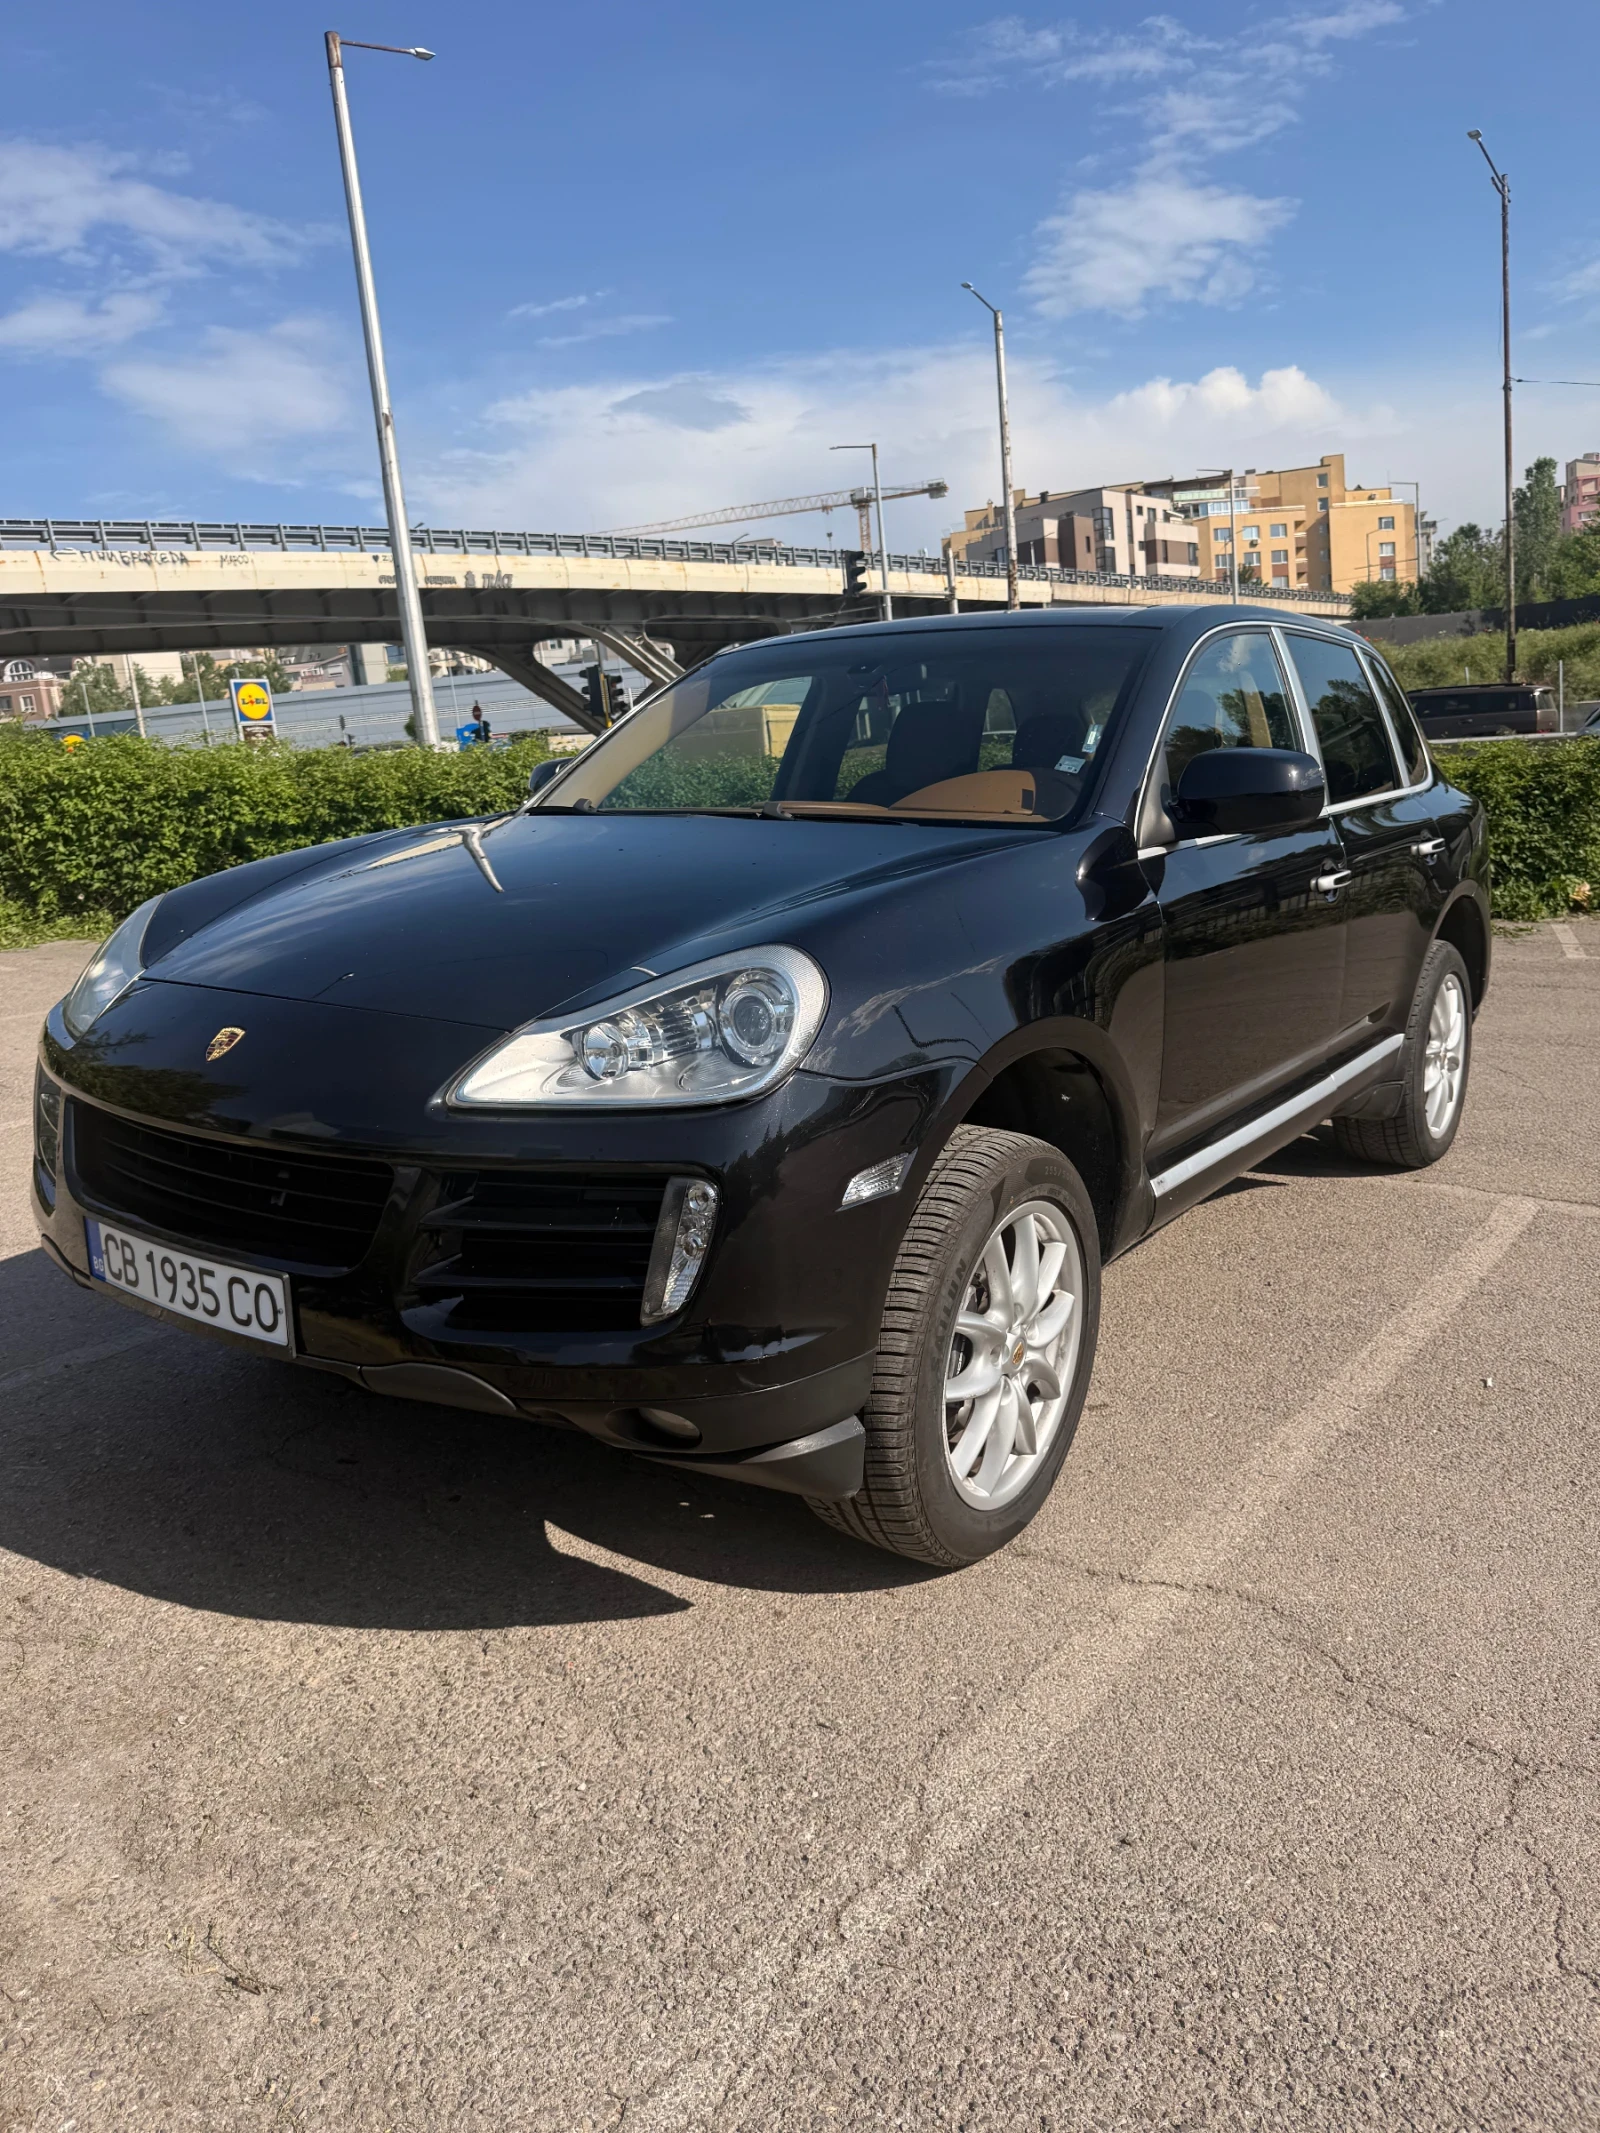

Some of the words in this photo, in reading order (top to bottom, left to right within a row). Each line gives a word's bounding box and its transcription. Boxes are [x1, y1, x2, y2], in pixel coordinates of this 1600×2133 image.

[93, 1255, 105, 1273] BG
[104, 1233, 139, 1288] CB
[146, 1250, 221, 1317] 1935
[227, 1276, 279, 1333] CO
